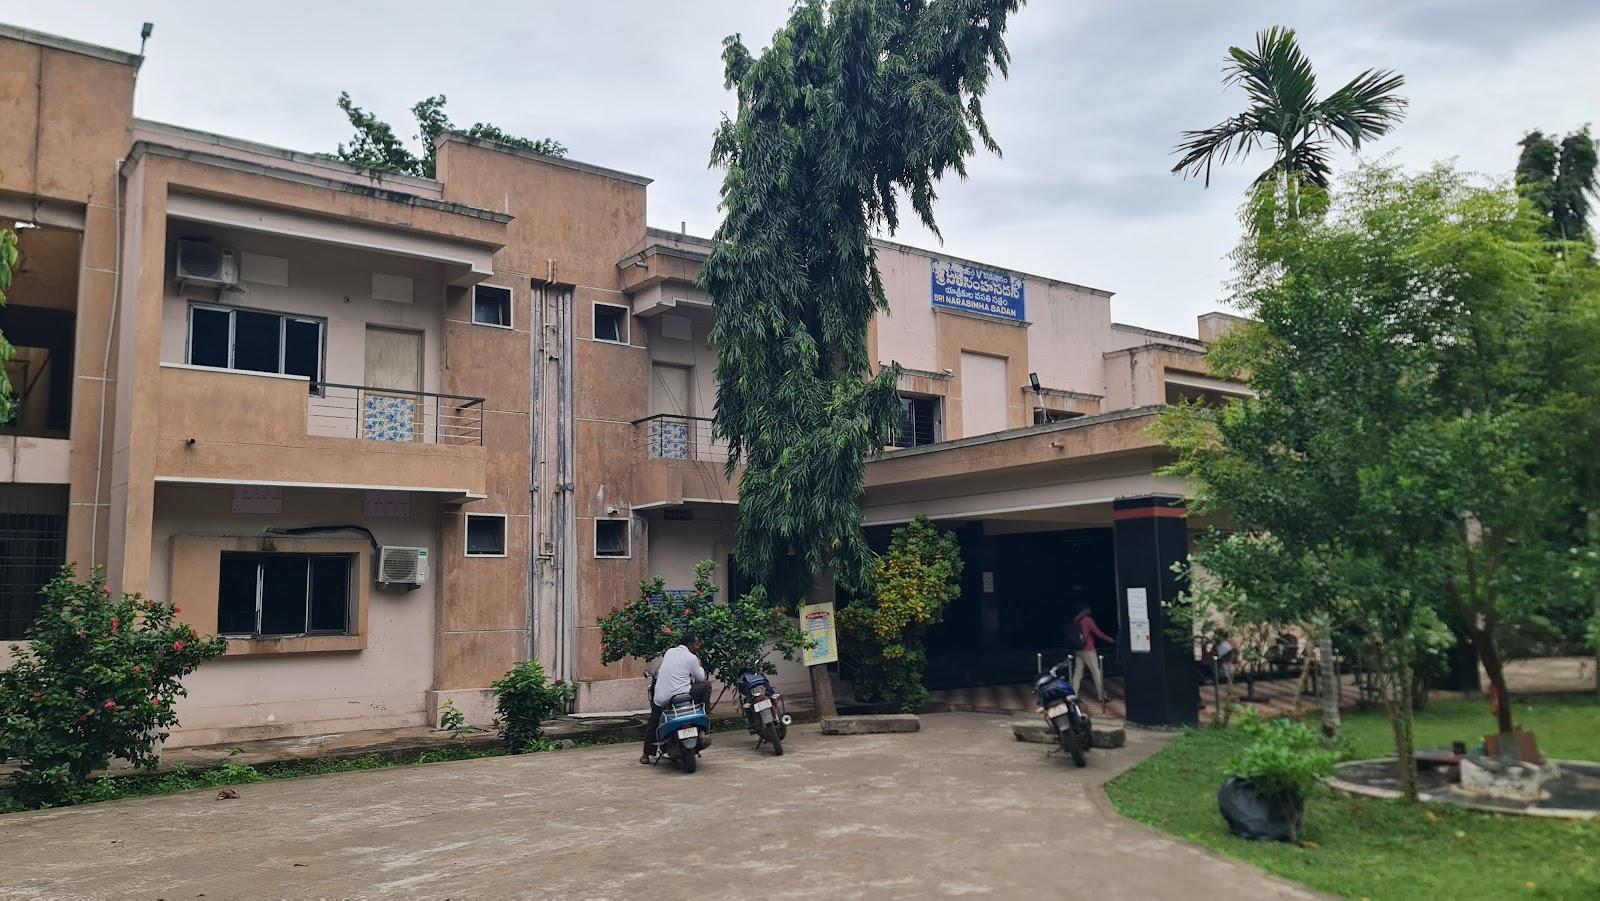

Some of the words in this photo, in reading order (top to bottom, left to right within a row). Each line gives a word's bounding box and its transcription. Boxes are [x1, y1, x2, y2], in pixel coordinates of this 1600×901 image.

[933, 293, 944, 303] SRI
[990, 304, 1017, 317] SADAN
[974, 292, 991, 302] వసతి
